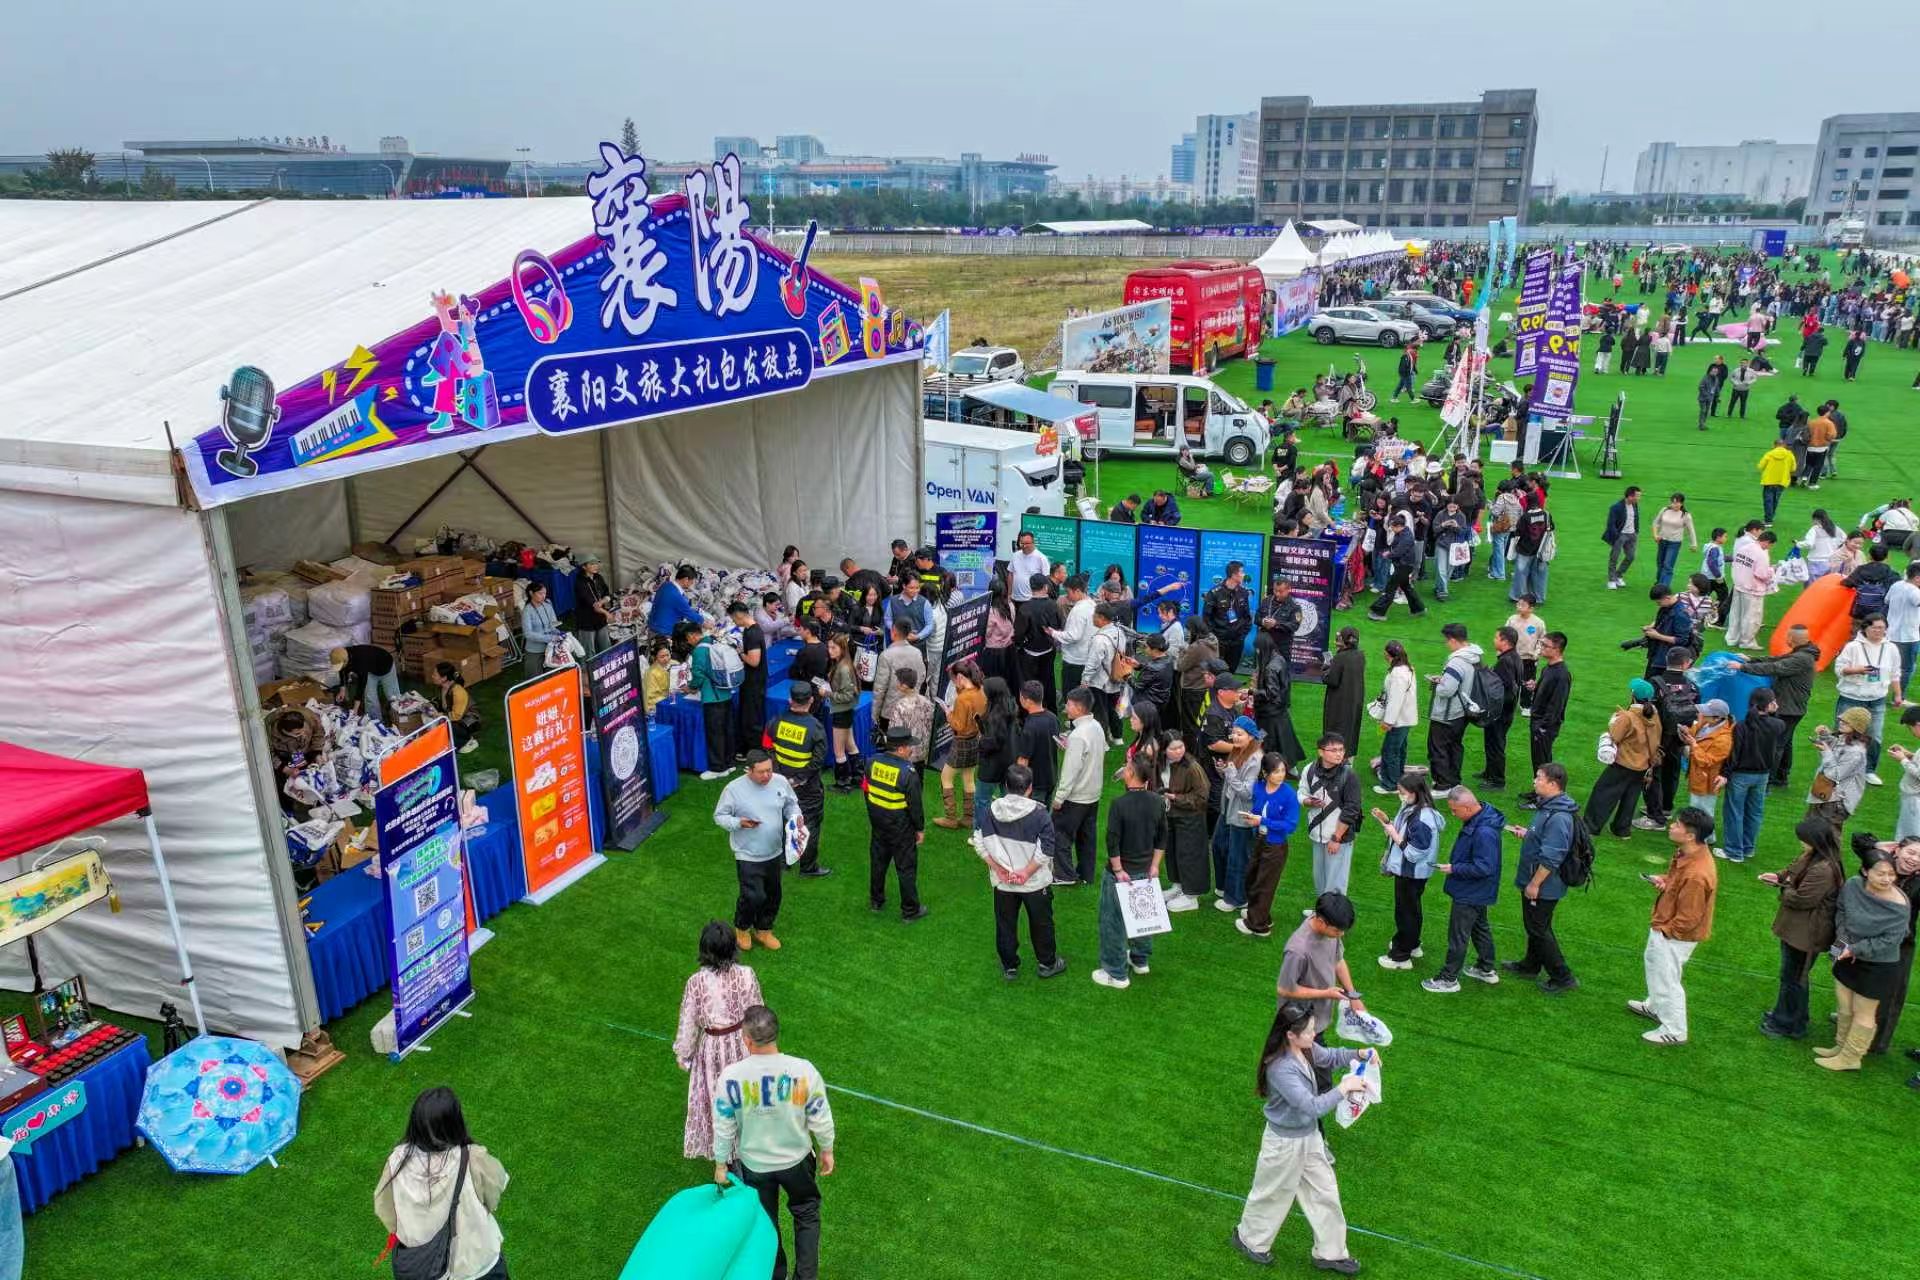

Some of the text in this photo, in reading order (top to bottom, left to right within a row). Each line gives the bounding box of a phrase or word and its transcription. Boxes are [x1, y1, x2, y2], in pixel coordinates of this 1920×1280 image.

[547, 339, 804, 423] 襄阳文旅大礼包发放点
[926, 481, 995, 505] Open VAN
